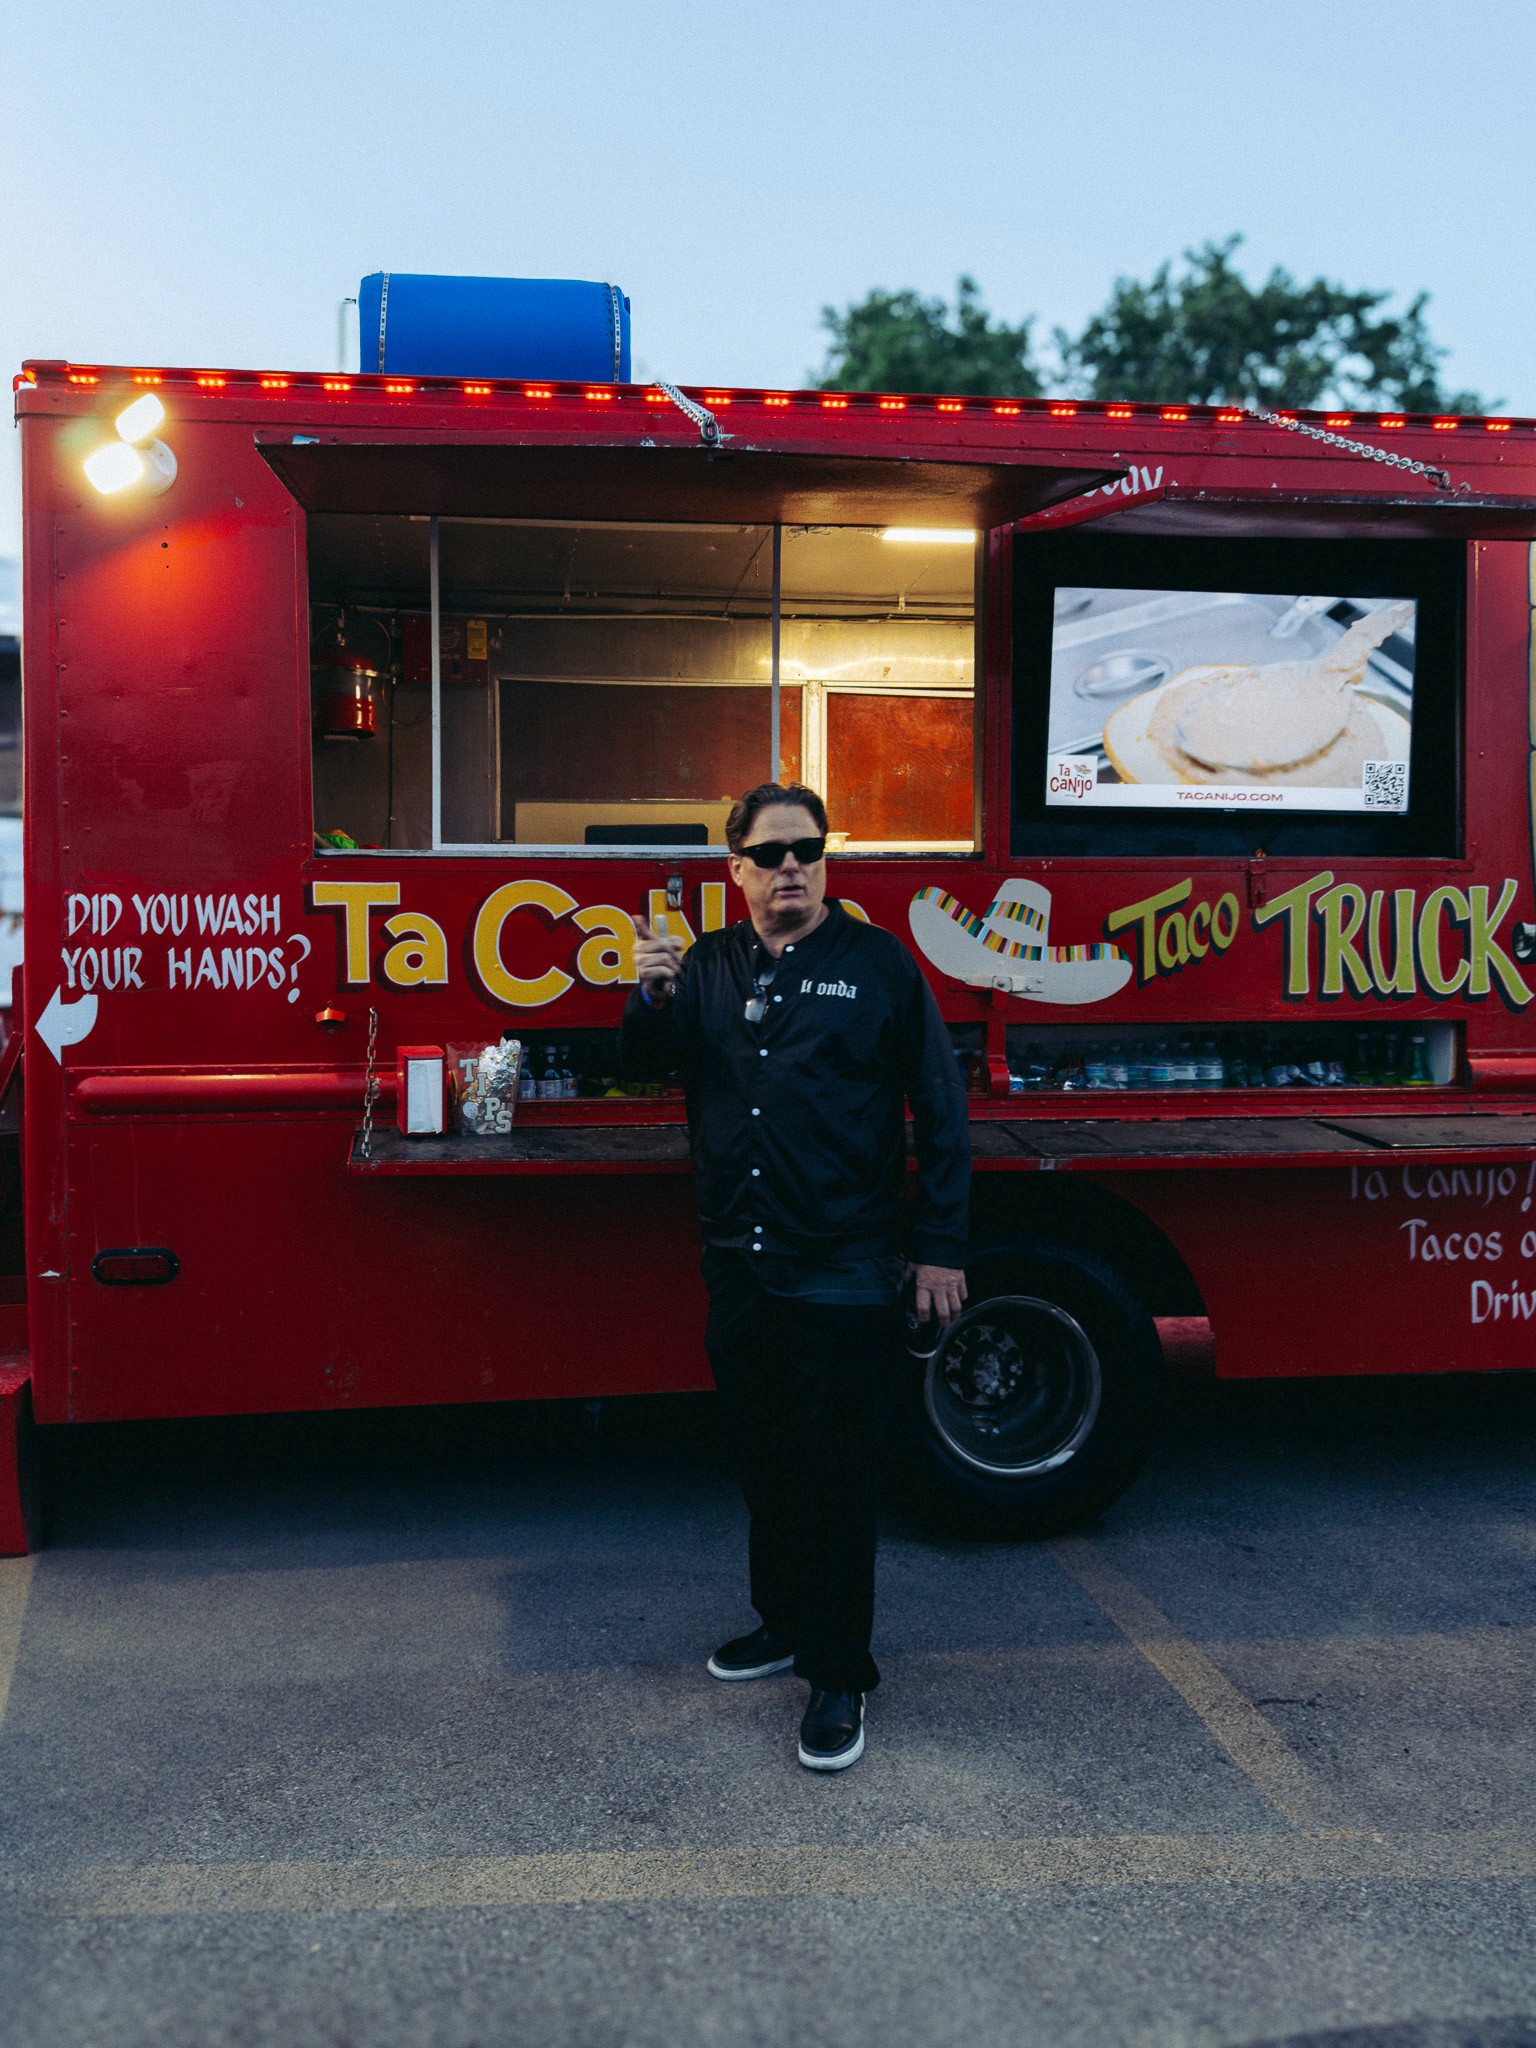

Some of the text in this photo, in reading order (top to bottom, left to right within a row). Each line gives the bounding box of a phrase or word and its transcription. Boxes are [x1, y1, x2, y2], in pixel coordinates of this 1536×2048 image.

[1058, 763, 1071, 777] Ta
[1176, 791, 1284, 802] TACANIJO.COM
[68, 893, 281, 936] DID YOU WASH
[312, 880, 450, 986] Ta
[1108, 870, 1535, 1005] Taco TRUCK
[61, 933, 312, 1004] YOUR HANDS?
[816, 980, 857, 999] onda
[1399, 1218, 1503, 1262] Tacos
